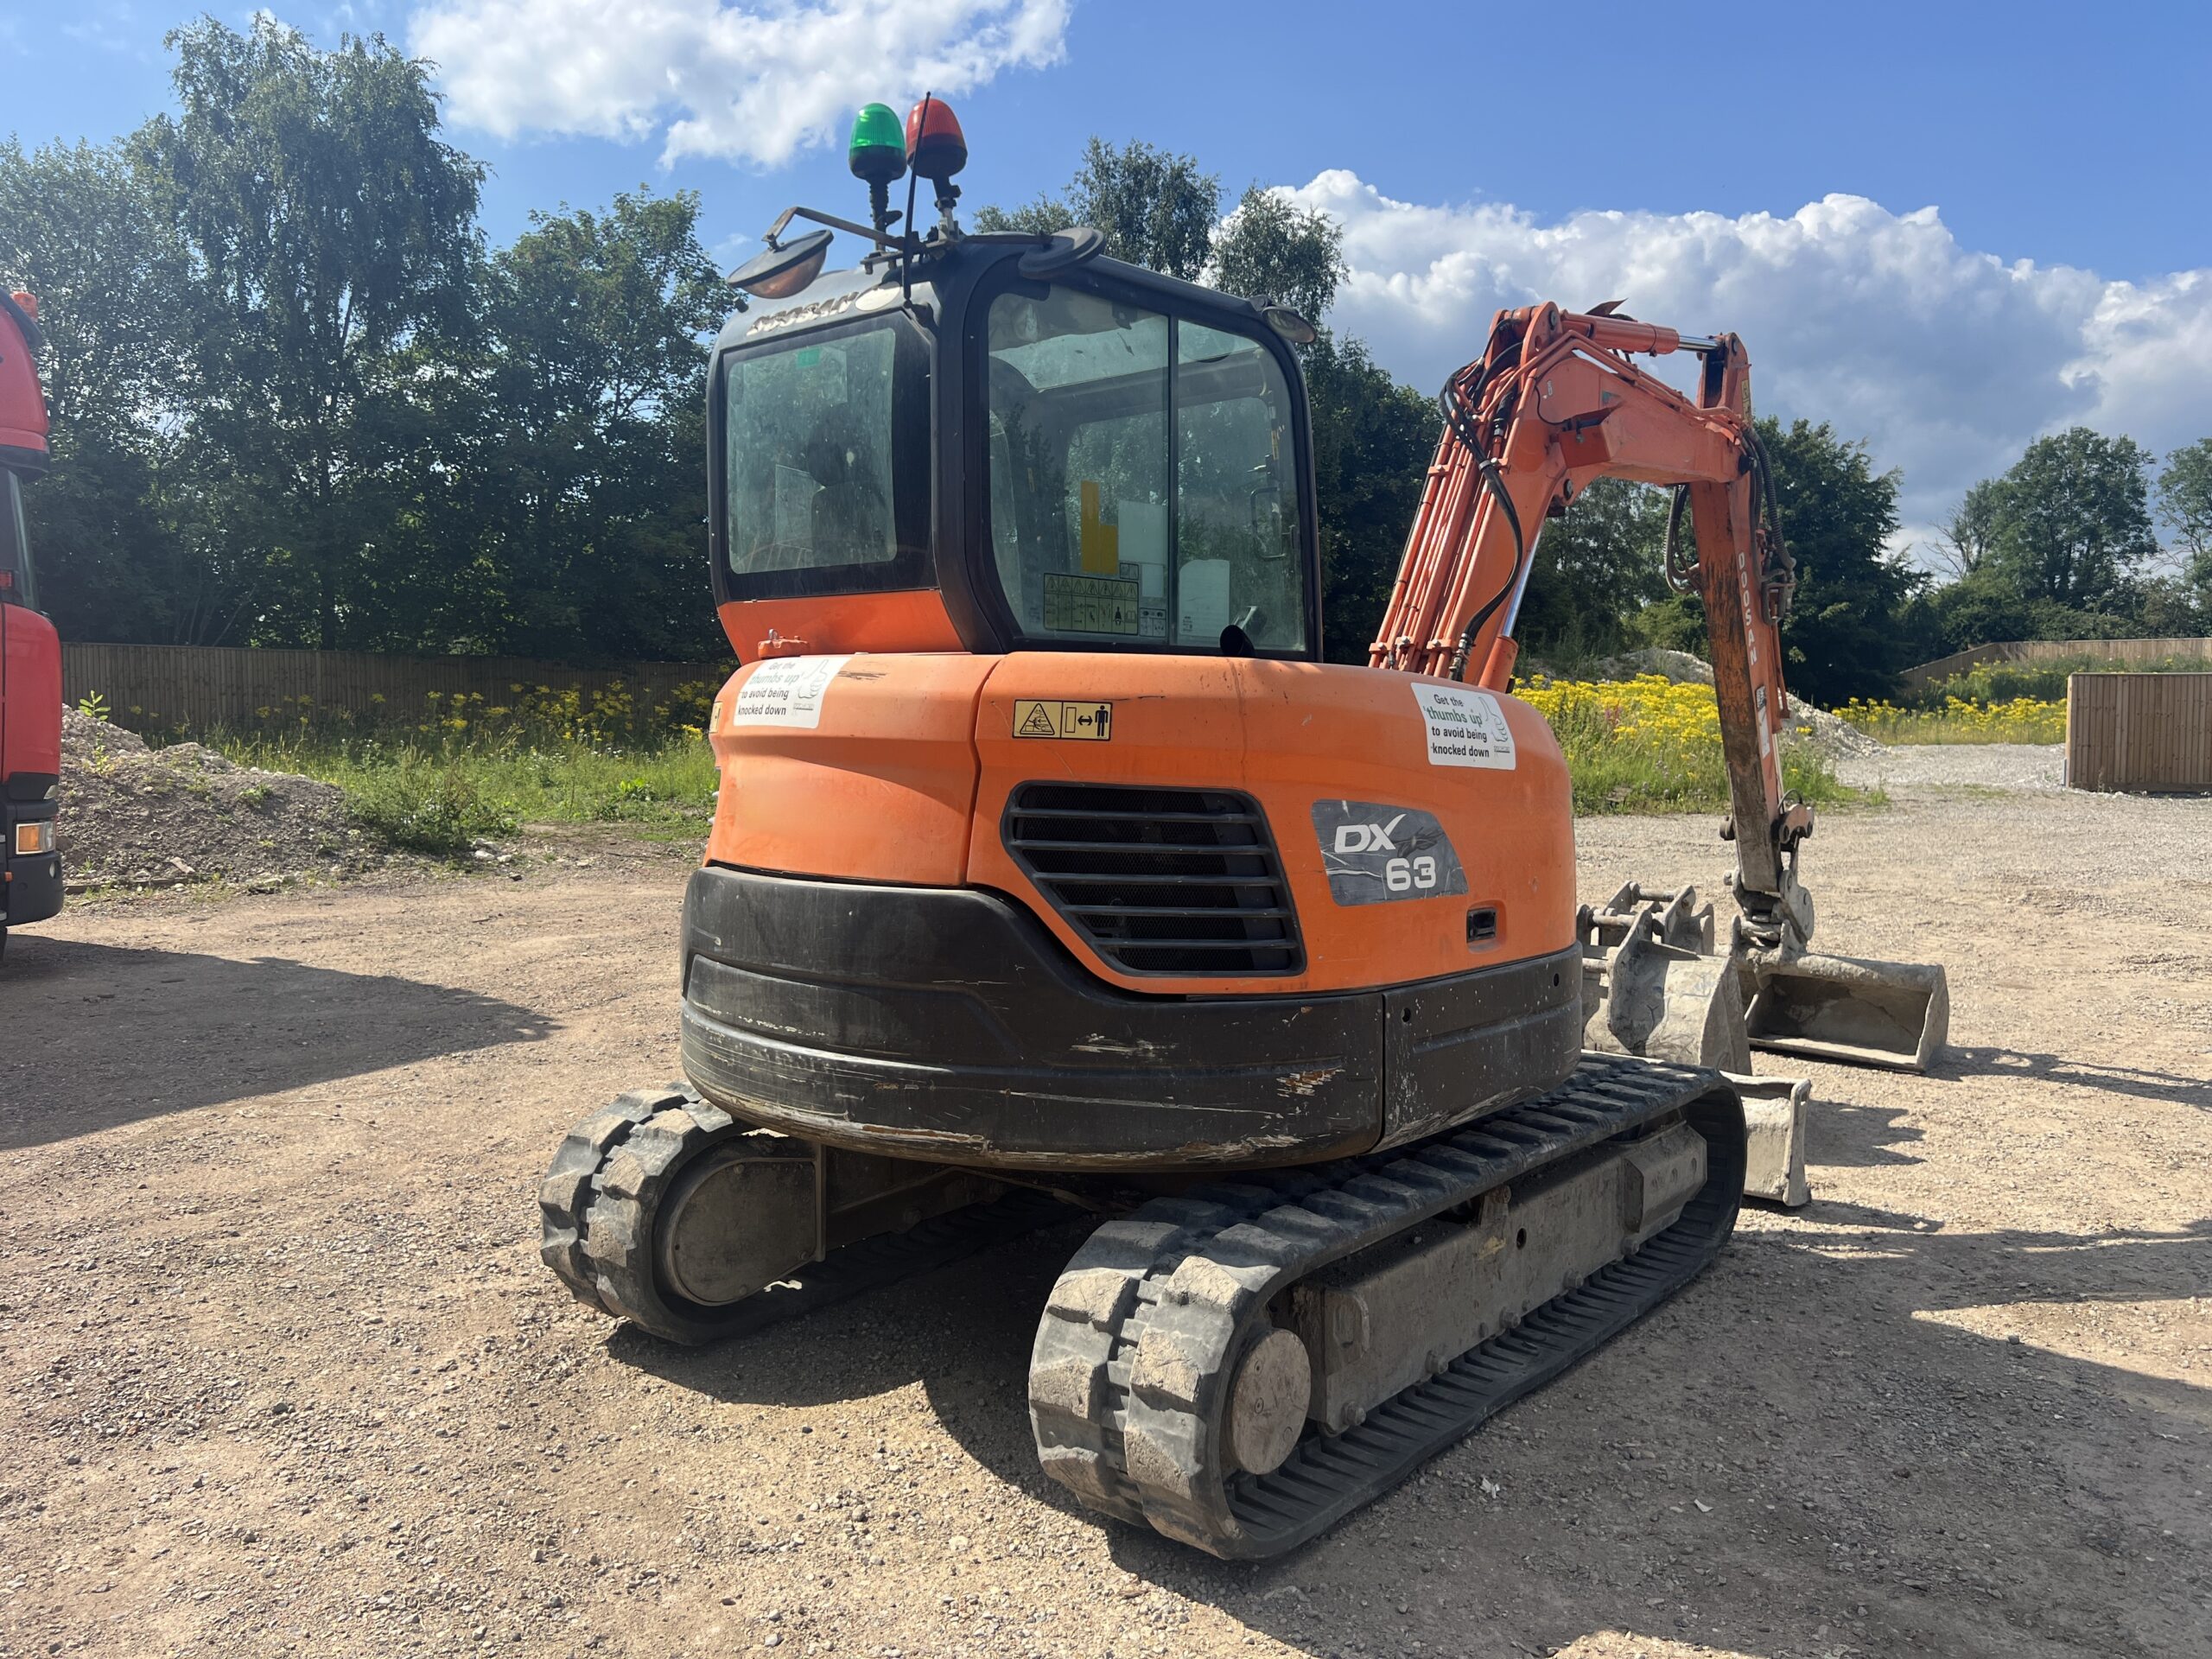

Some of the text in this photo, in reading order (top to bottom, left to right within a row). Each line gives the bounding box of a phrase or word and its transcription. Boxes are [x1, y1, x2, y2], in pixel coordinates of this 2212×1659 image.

[1738, 552, 1758, 665] DOOSAN
[748, 688, 767, 698] avoid
[767, 688, 789, 701] being
[1433, 694, 1464, 707] Get the
[738, 703, 764, 715] knocked
[765, 703, 786, 715] down
[1432, 726, 1487, 743] to avoid being
[1432, 742, 1466, 756] knocked
[1468, 746, 1490, 758] down
[1334, 813, 1408, 853] DX
[1386, 855, 1437, 892] 63
